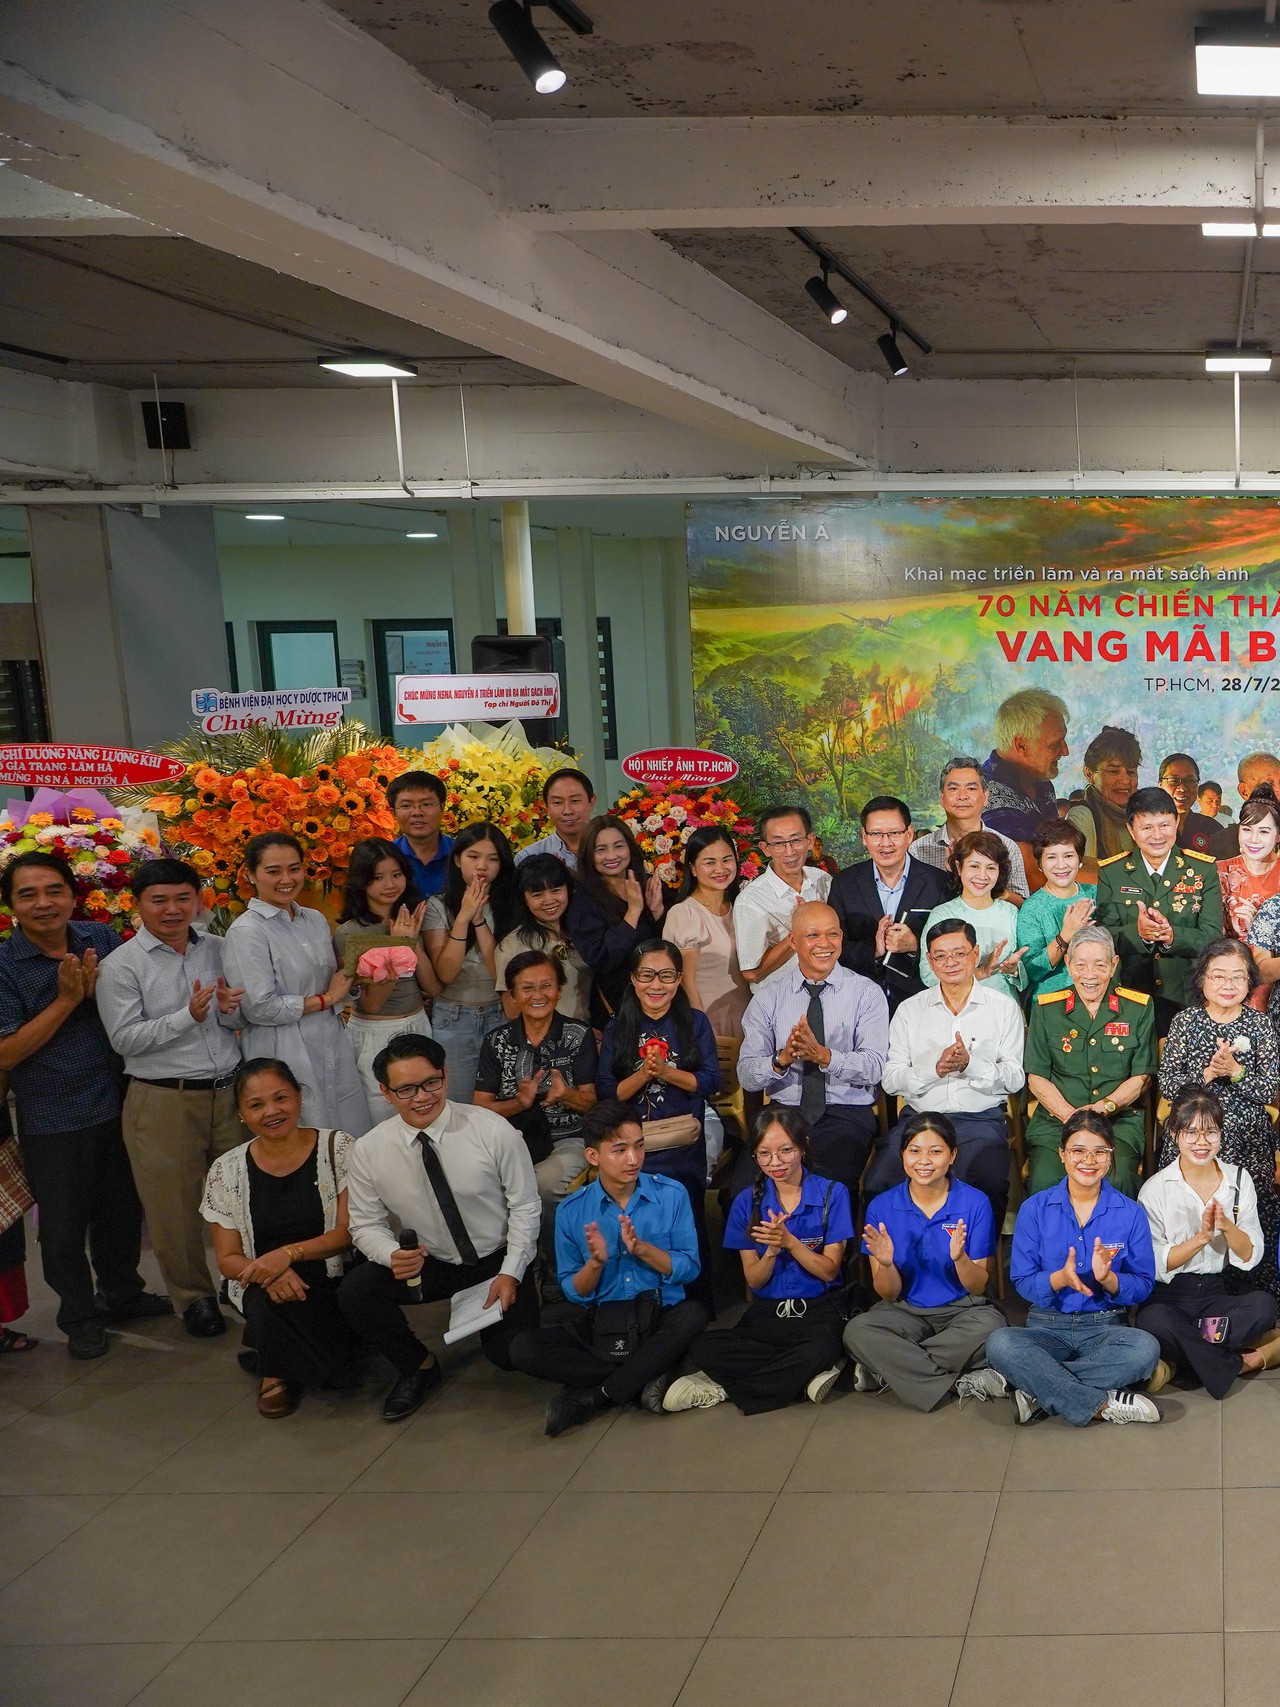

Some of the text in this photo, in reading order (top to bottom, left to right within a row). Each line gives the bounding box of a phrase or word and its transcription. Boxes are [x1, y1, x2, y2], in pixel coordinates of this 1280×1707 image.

[715, 520, 830, 541] NGUYỄN Á
[904, 566, 1250, 583] Khai mạc triển lãm và ra mắt sách ảnh
[978, 595, 1016, 617] 70
[1030, 590, 1101, 617] NĂM
[1115, 588, 1214, 617] CHIẾN
[996, 630, 1128, 662] VANG
[1146, 623, 1230, 662] MÃI
[404, 689, 419, 700] CHÚC
[420, 688, 436, 700] MỪNG
[454, 686, 475, 699] NGUYỄN
[513, 688, 519, 697] RA
[531, 686, 543, 697] SÁCH
[1144, 678, 1215, 693] TP.HCM,
[219, 696, 241, 712] BỆNH
[242, 693, 260, 710] VIỆN
[260, 694, 275, 709] ĐẠI
[276, 693, 294, 708] HỌC
[293, 692, 299, 701] Y
[300, 690, 322, 706] DƯỢC
[323, 690, 349, 702] TPHCM
[484, 701, 497, 709] Tạp
[510, 700, 530, 708] Người
[273, 709, 340, 728] Mừng
[628, 756, 732, 773] HỘI NHIẾP ẢNH TP.HCM
